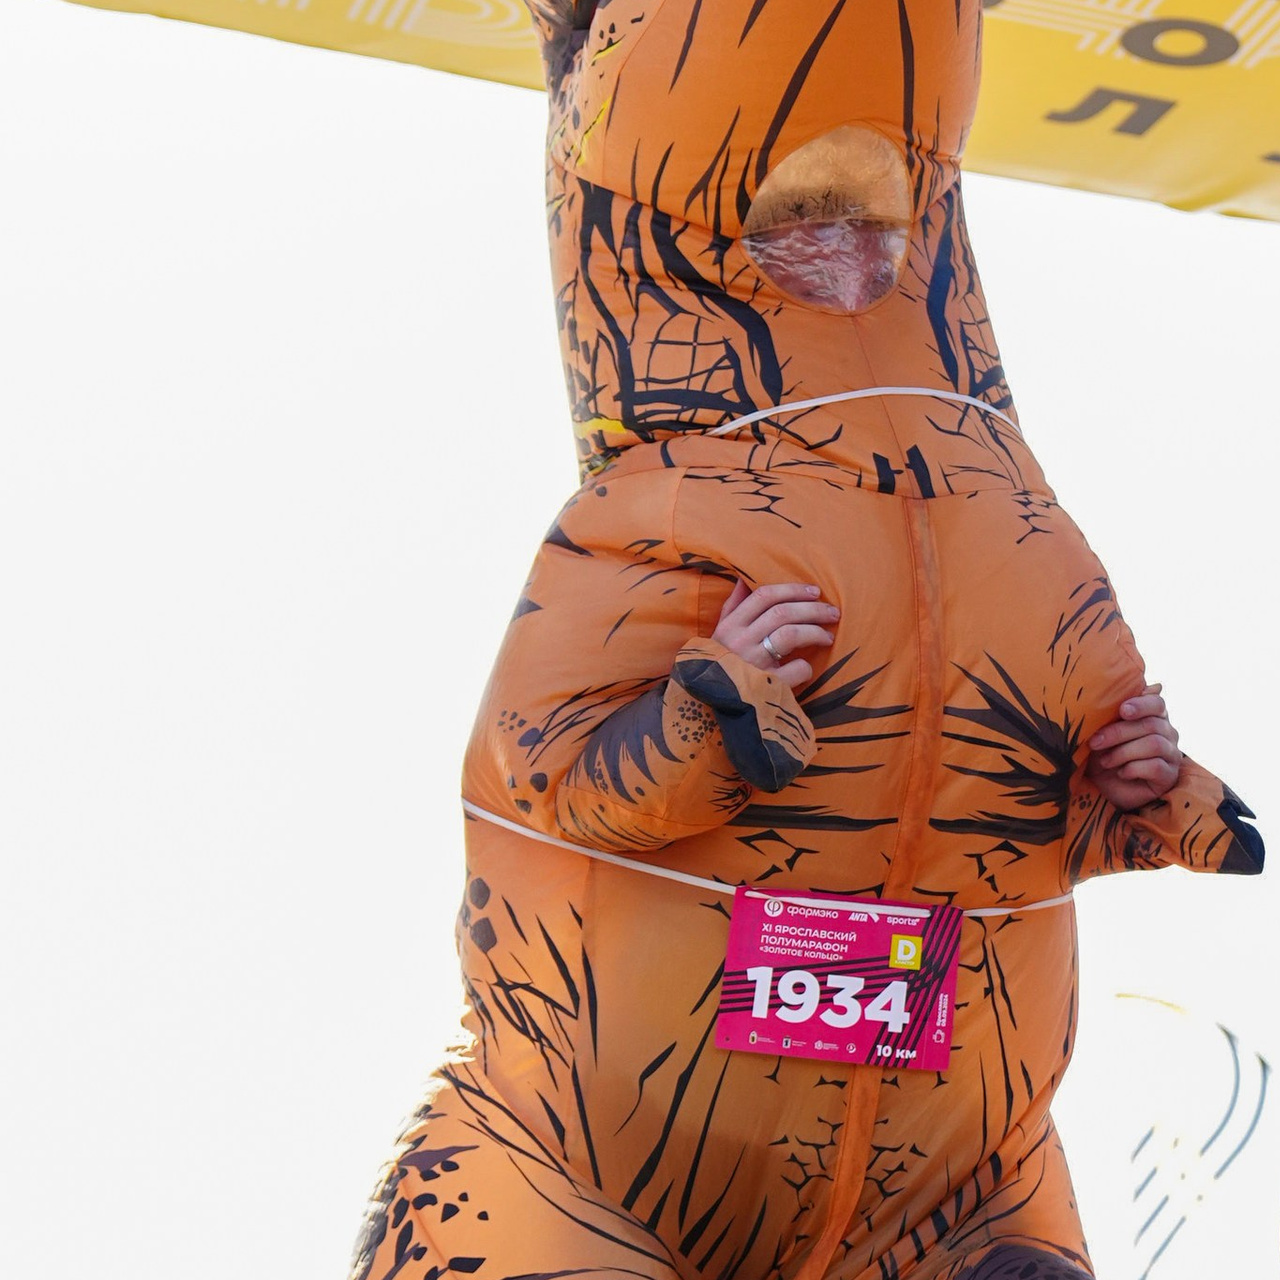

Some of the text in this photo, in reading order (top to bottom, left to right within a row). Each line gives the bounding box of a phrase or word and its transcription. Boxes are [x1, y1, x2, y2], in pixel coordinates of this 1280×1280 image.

[787, 905, 839, 919] фармэко
[887, 916, 919, 926] sports
[774, 924, 857, 942] ЯРОСЛАВСКИЙ
[760, 935, 848, 953] ПОЛУМАРАФОН
[897, 939, 917, 961] D
[746, 966, 910, 1033] 1934
[876, 1044, 892, 1057] 10
